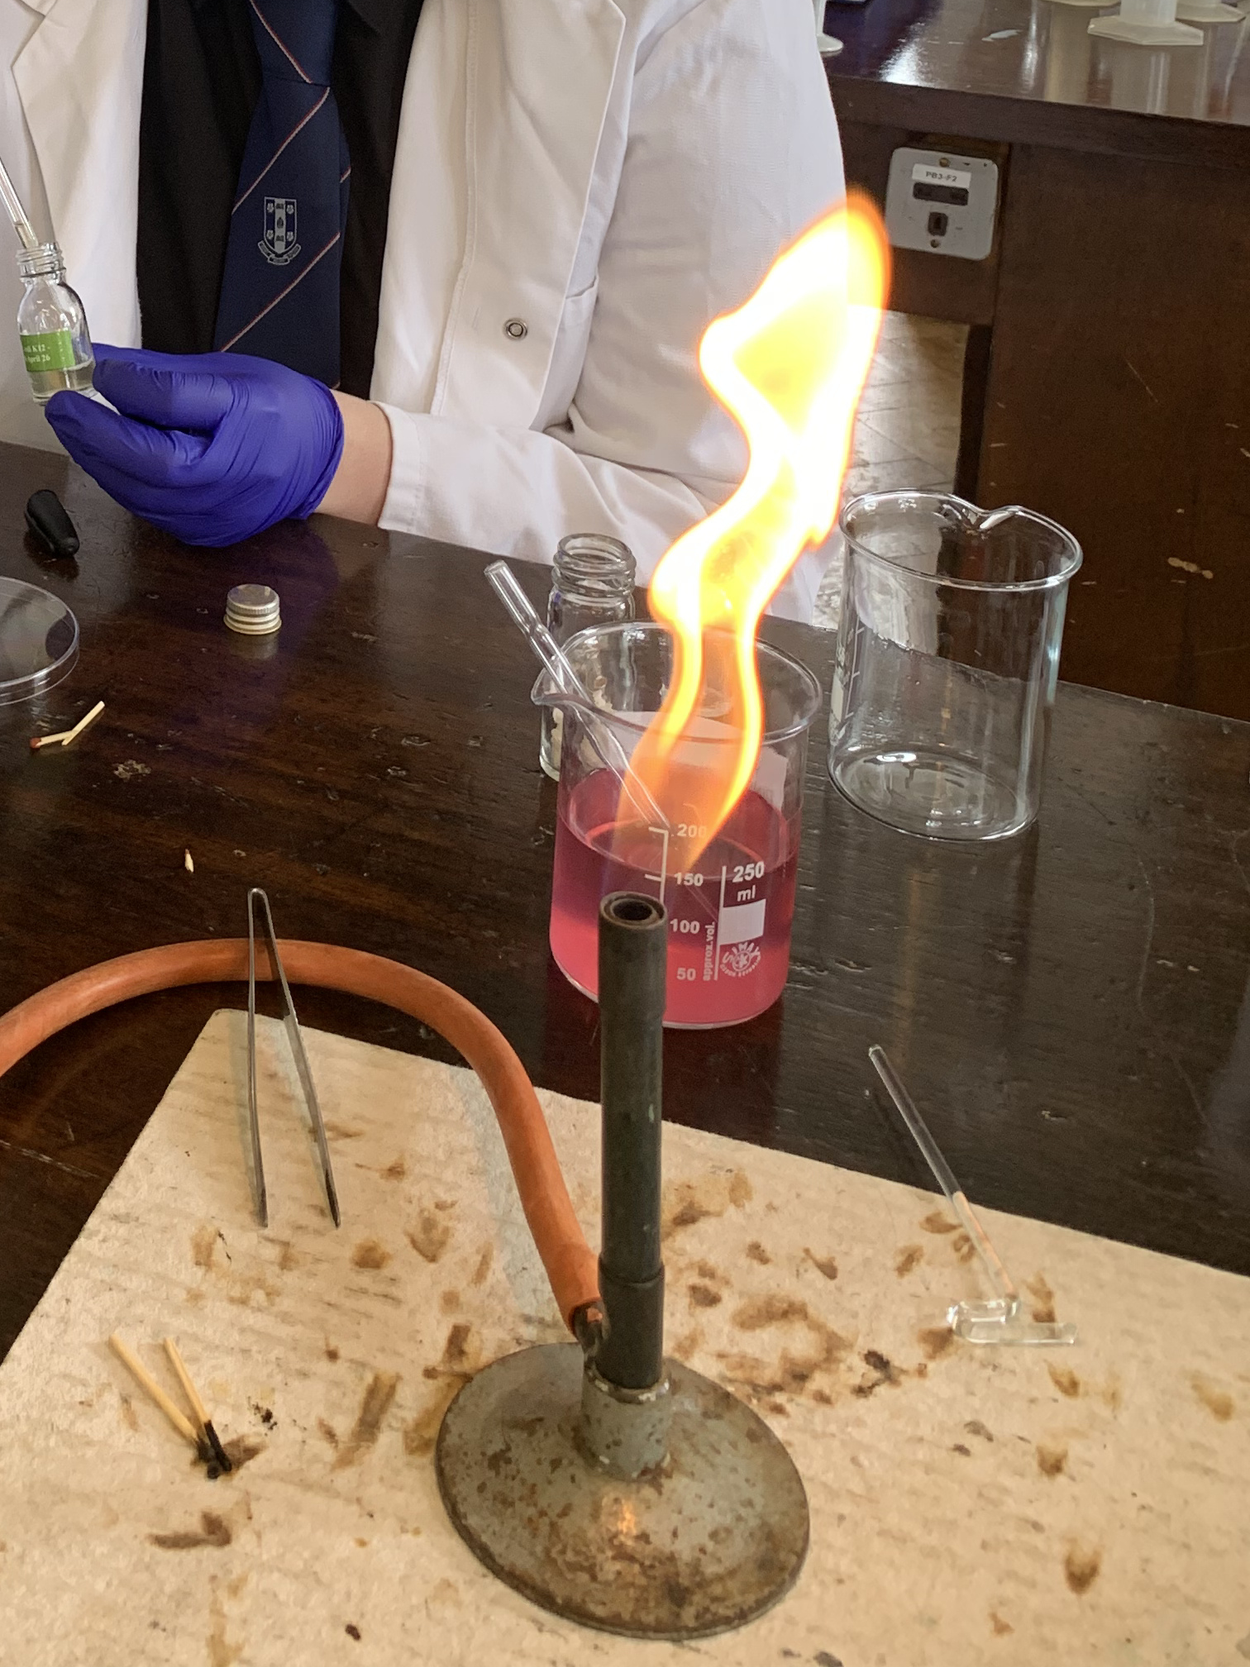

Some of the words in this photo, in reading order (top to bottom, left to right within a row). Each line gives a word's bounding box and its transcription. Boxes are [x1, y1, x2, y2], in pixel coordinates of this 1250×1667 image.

[41, 354, 51, 362] 26
[673, 871, 704, 887] 150
[732, 860, 765, 883] 250
[736, 885, 756, 902] ml
[669, 918, 700, 934] 100
[676, 966, 696, 982] 50
